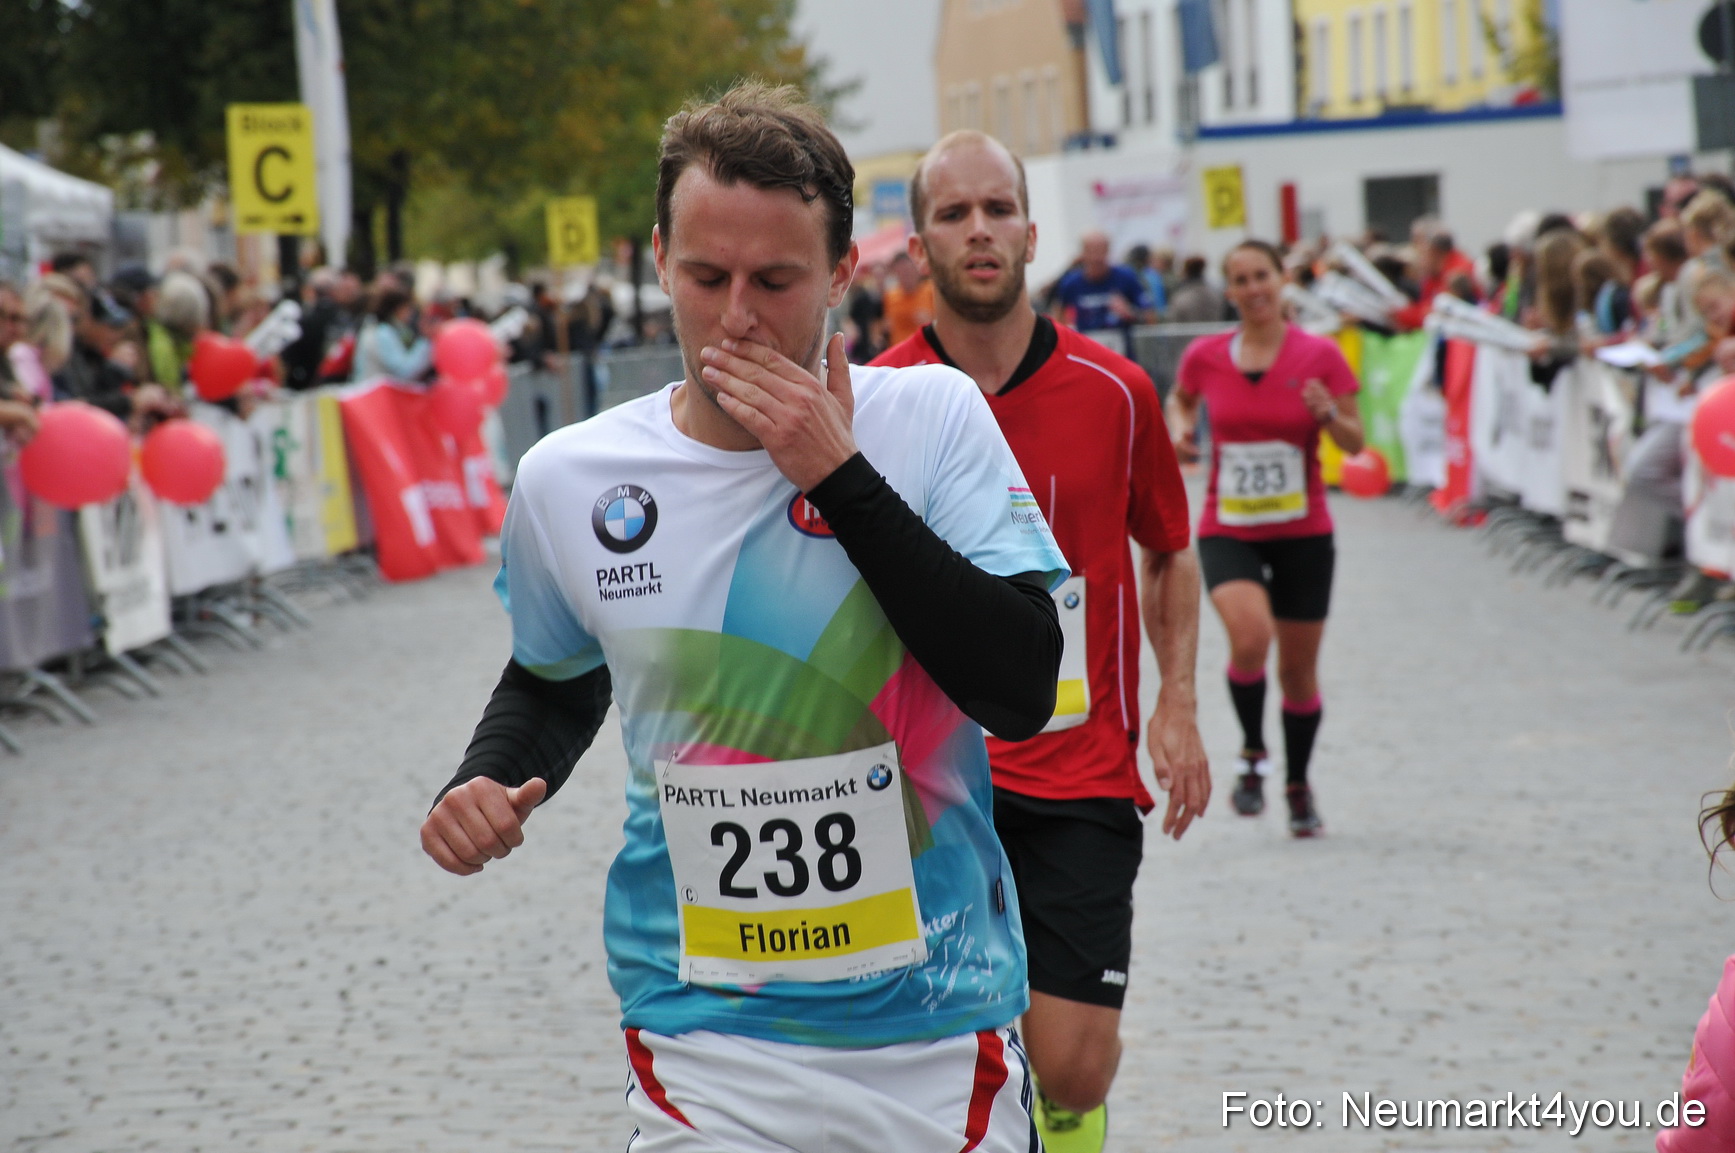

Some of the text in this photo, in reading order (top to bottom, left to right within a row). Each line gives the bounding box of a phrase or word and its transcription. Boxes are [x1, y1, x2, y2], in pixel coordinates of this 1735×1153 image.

[253, 144, 294, 205] C
[1232, 462, 1287, 496] 283
[597, 485, 652, 510] BMW
[596, 561, 662, 587] PARTL
[599, 581, 663, 602] Neumarkt
[664, 777, 858, 808] PARTL Neumarkt
[710, 811, 862, 899] 238
[738, 919, 851, 955] Florian
